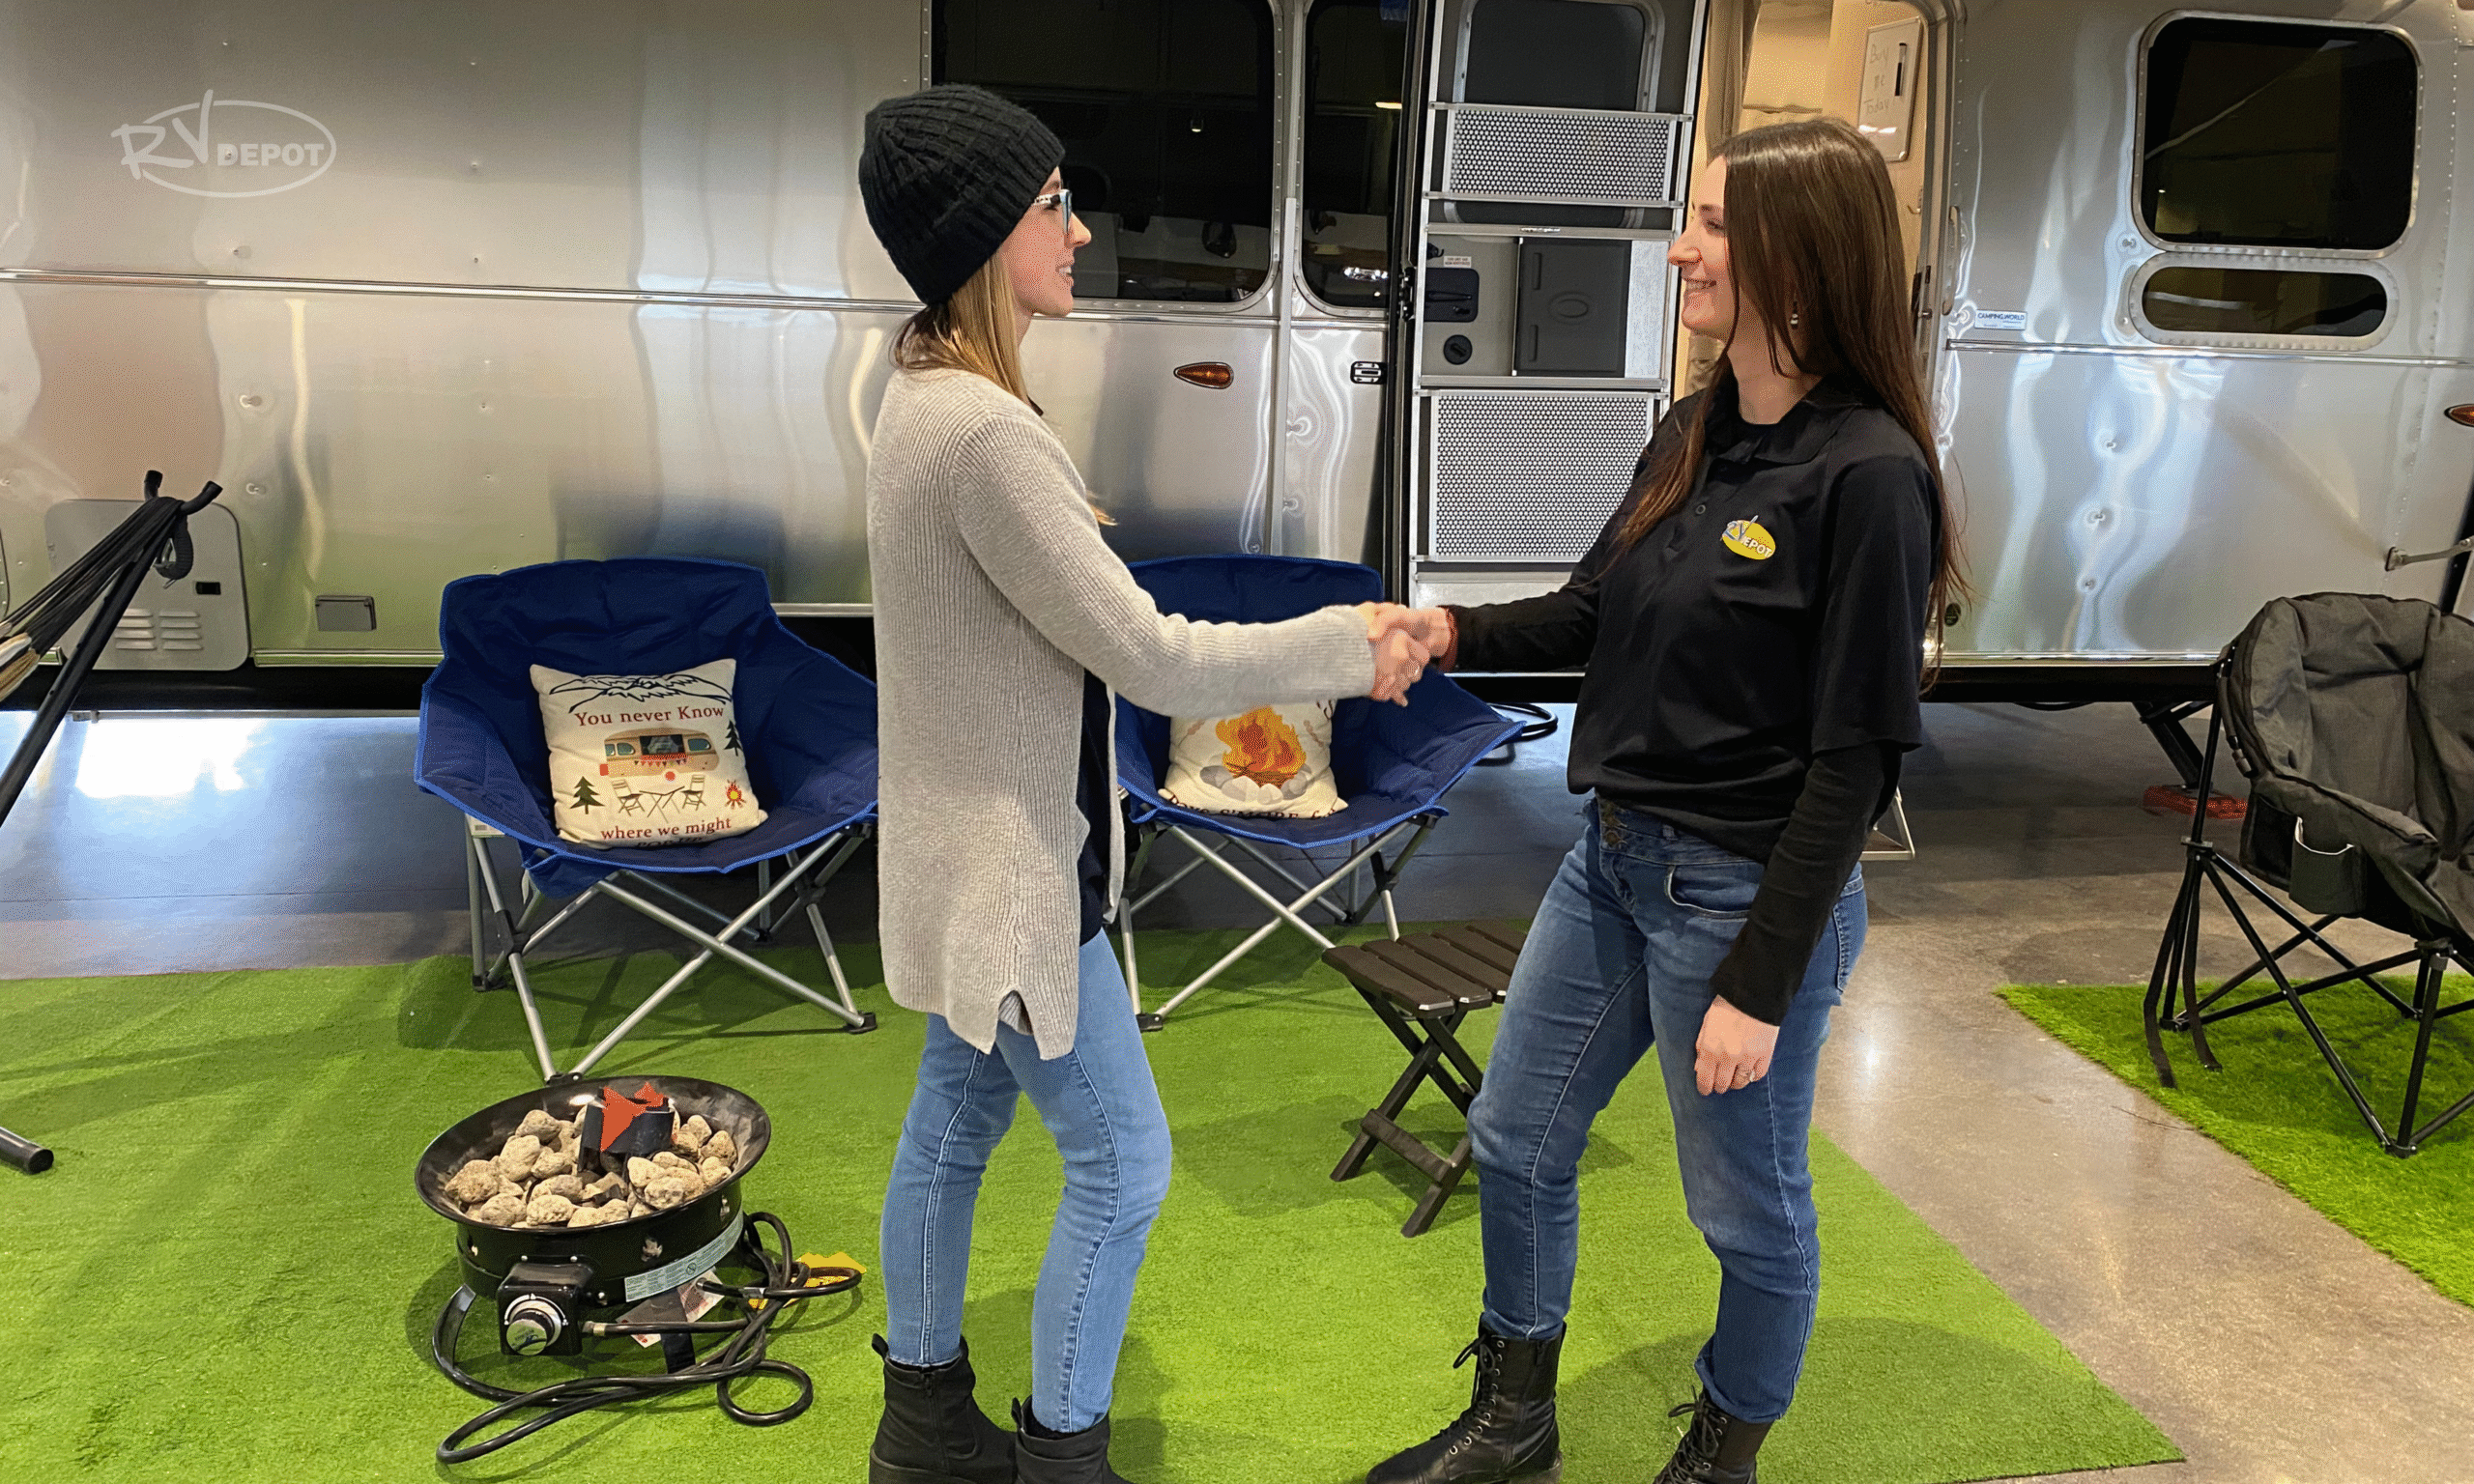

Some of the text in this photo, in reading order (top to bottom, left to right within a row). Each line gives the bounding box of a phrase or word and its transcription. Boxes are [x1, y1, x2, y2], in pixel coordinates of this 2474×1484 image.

[574, 705, 724, 726] You never Know
[600, 816, 732, 840] where we might
